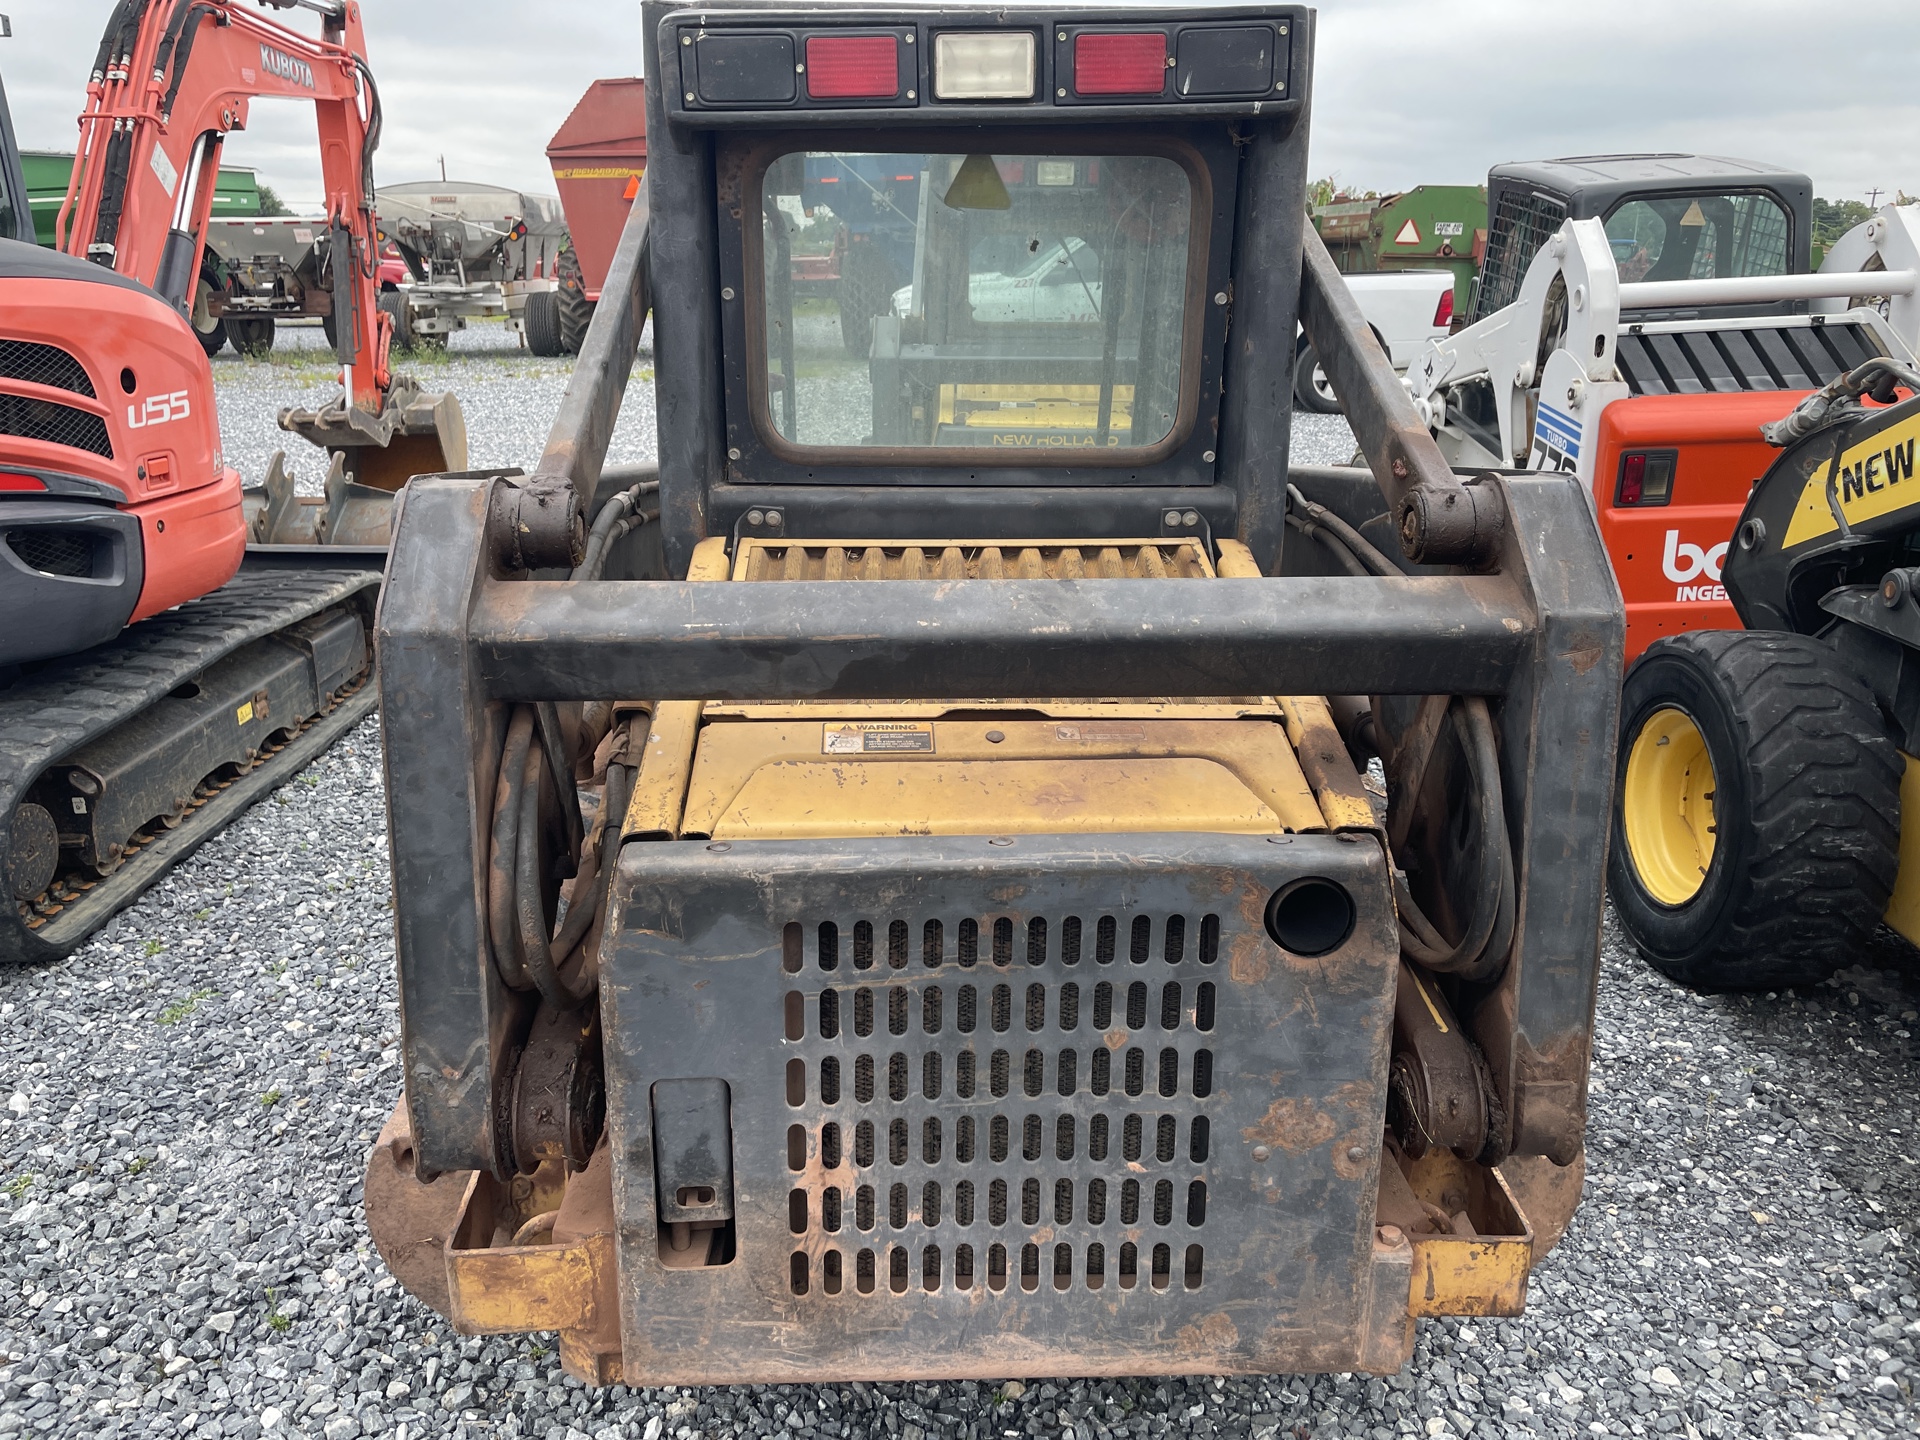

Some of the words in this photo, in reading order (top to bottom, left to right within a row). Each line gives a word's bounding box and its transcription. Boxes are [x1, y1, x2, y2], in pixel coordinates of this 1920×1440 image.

[260, 43, 315, 91] KUBOTA
[1014, 278, 1035, 288] 227
[127, 389, 191, 429] U55
[993, 434, 1033, 446] NEW
[1036, 434, 1119, 447] HOLLAD
[1546, 429, 1568, 451] TURBO
[1841, 436, 1915, 504] NEW
[1676, 585, 1731, 602] INGE
